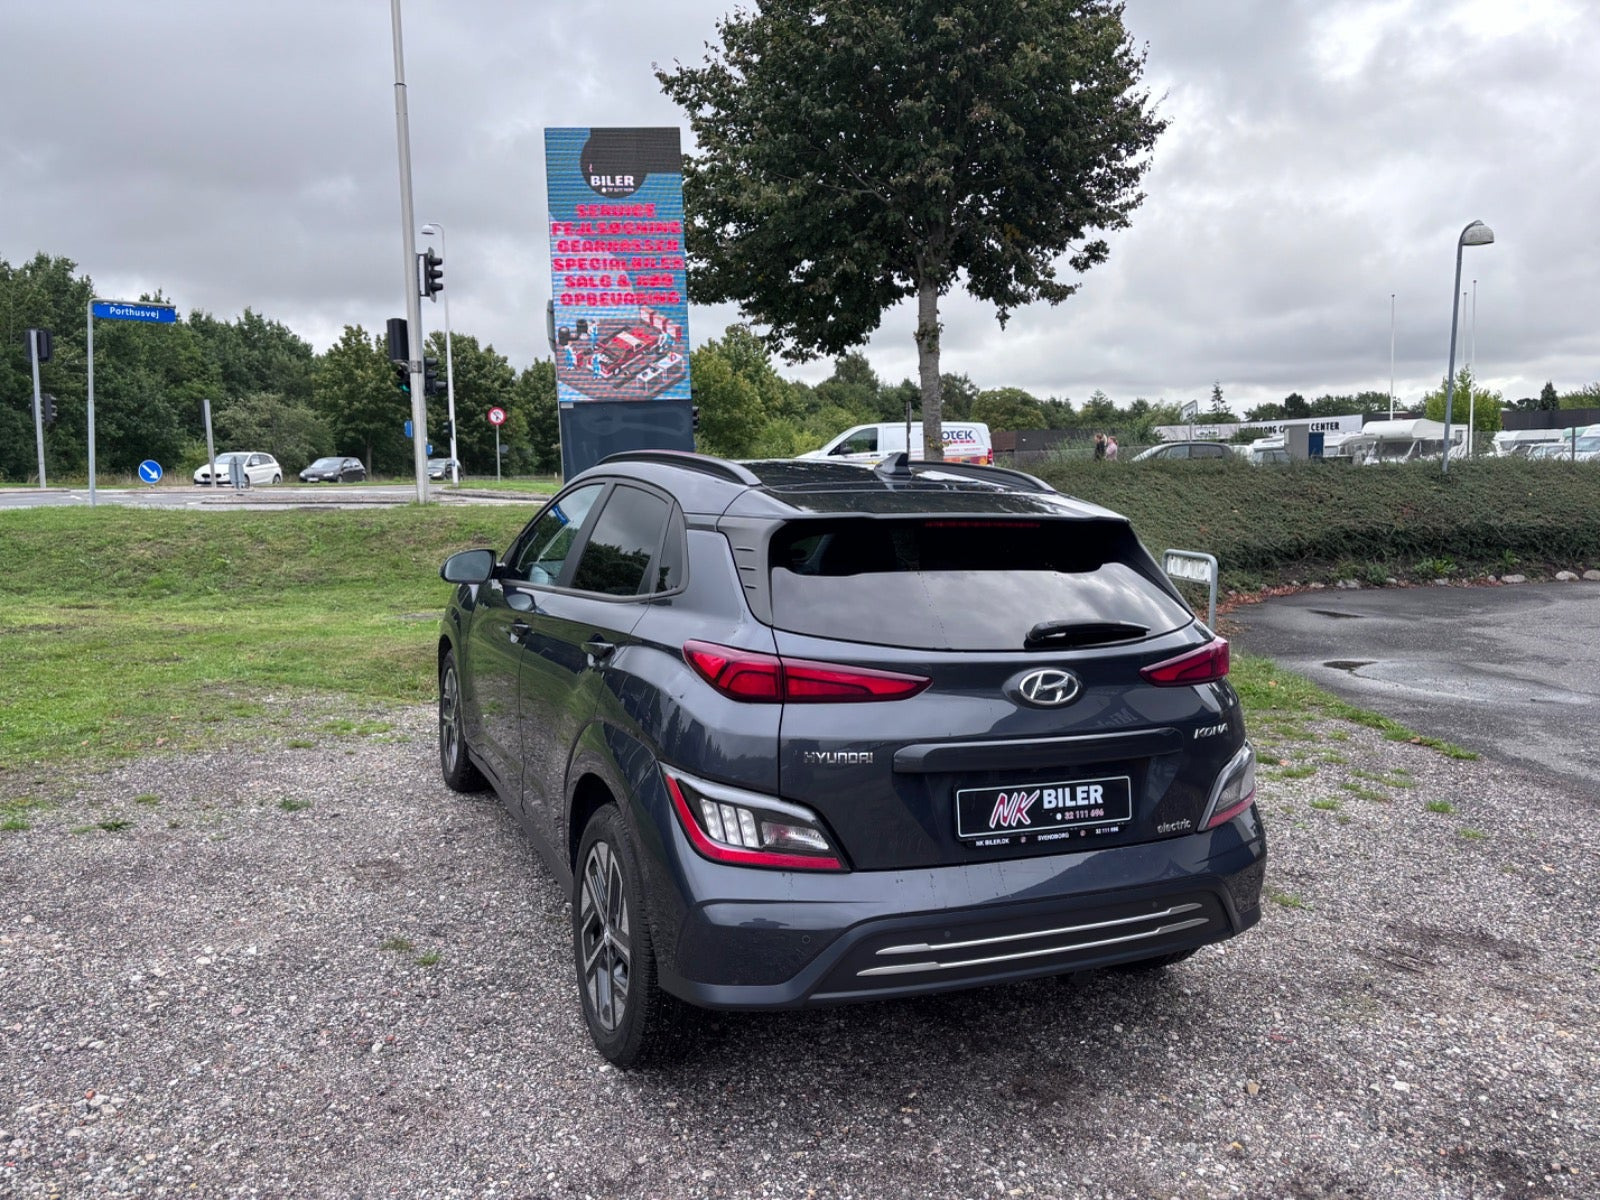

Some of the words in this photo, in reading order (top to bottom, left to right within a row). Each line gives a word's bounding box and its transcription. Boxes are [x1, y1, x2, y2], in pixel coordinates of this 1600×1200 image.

[590, 175, 634, 186] BILER
[564, 274, 612, 288] SALG
[109, 306, 159, 319] Porthusvej
[1311, 421, 1340, 431] CENTER
[941, 430, 974, 440] OTEK
[803, 751, 873, 764] HYUNDAI
[989, 789, 1040, 829] NK
[1042, 784, 1104, 809] BILER
[1064, 811, 1074, 820] 32
[1075, 809, 1089, 819] 111
[1090, 808, 1104, 817] 696
[1157, 818, 1191, 834] electric
[984, 838, 1010, 846] BILER.DK
[1037, 832, 1070, 841] SVENDBORG
